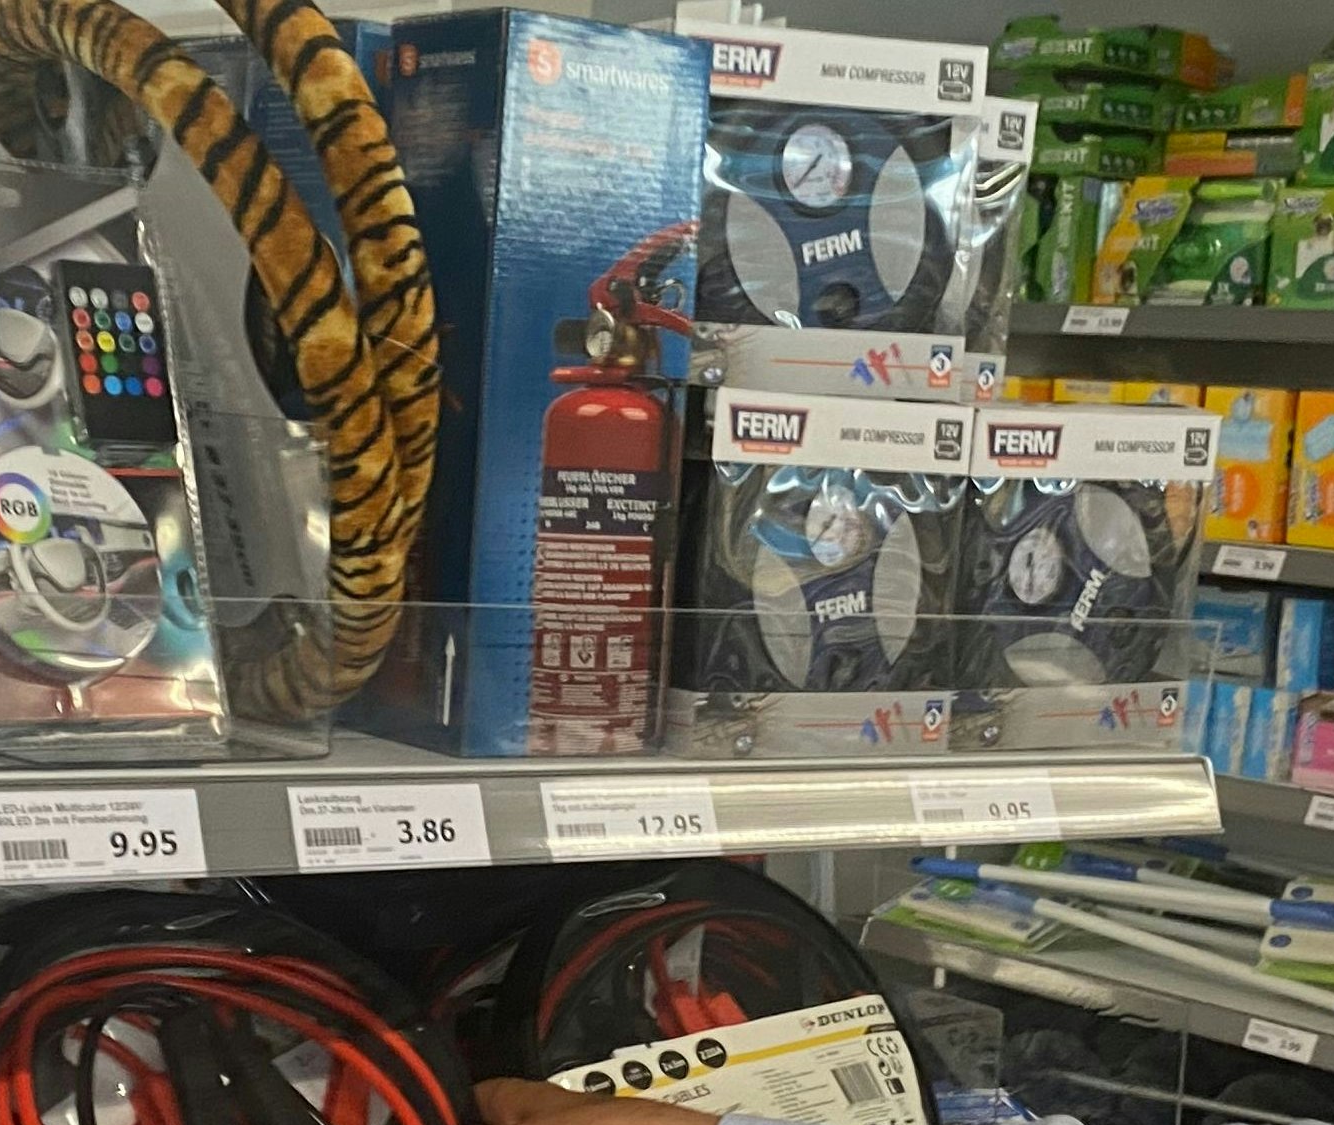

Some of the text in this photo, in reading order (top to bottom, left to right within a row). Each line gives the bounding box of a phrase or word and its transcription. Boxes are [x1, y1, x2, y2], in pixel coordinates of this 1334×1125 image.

[713, 42, 771, 75] ERM
[566, 61, 669, 92] smartwares
[821, 62, 926, 86] MINI COMPRESSOR
[801, 229, 863, 267] FERM
[737, 410, 799, 441] FERM
[994, 429, 1056, 456] FERM
[0, 498, 39, 517] RGB
[814, 590, 867, 623] FERM
[1070, 567, 1106, 632] FERM
[397, 818, 456, 844] 3.86
[637, 814, 703, 836] 12.95
[110, 829, 179, 858] 9.95
[816, 1004, 886, 1027] DUNLOP
